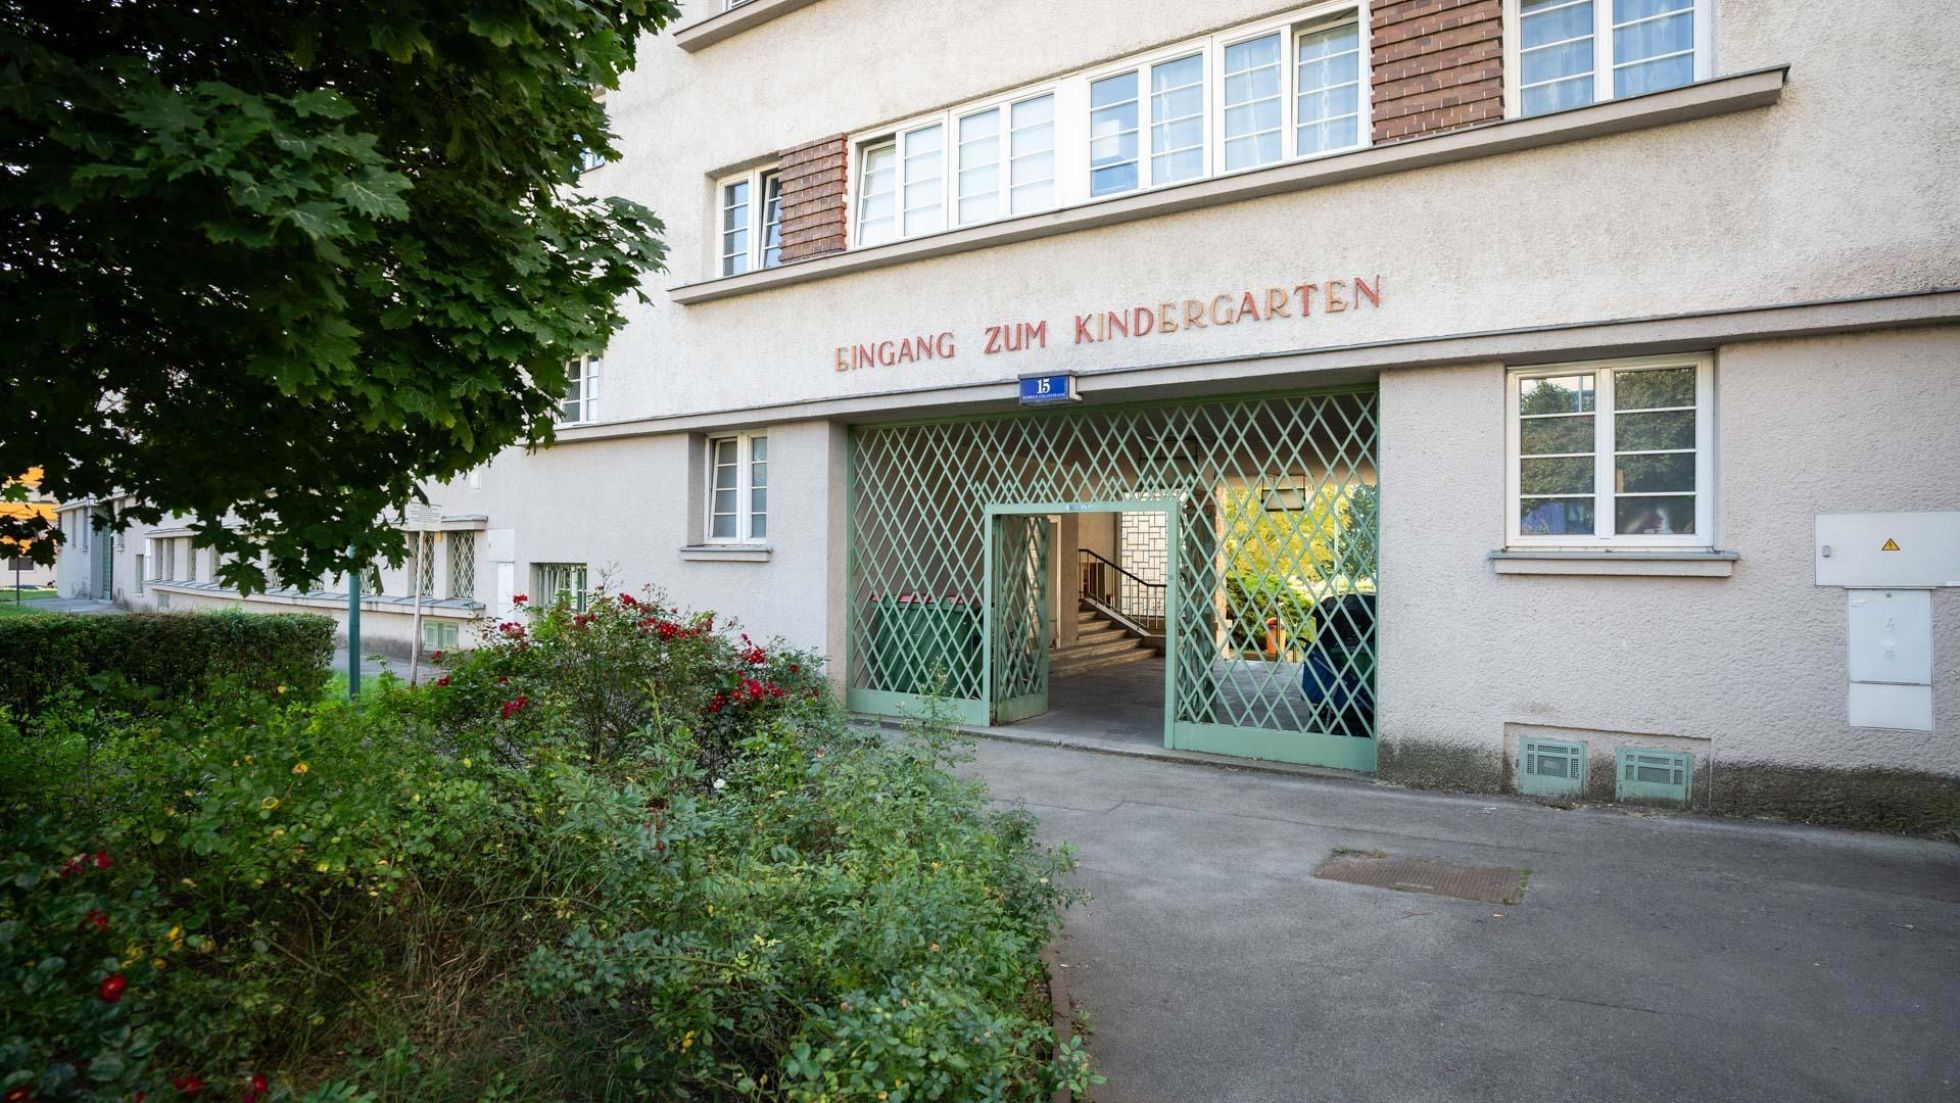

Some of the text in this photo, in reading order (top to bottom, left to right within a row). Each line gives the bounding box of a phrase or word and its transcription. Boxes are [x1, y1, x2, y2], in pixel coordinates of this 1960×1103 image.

[835, 275, 1381, 372] EINGANG ZUM KINDERGARTEN
[1036, 378, 1051, 394] 15
